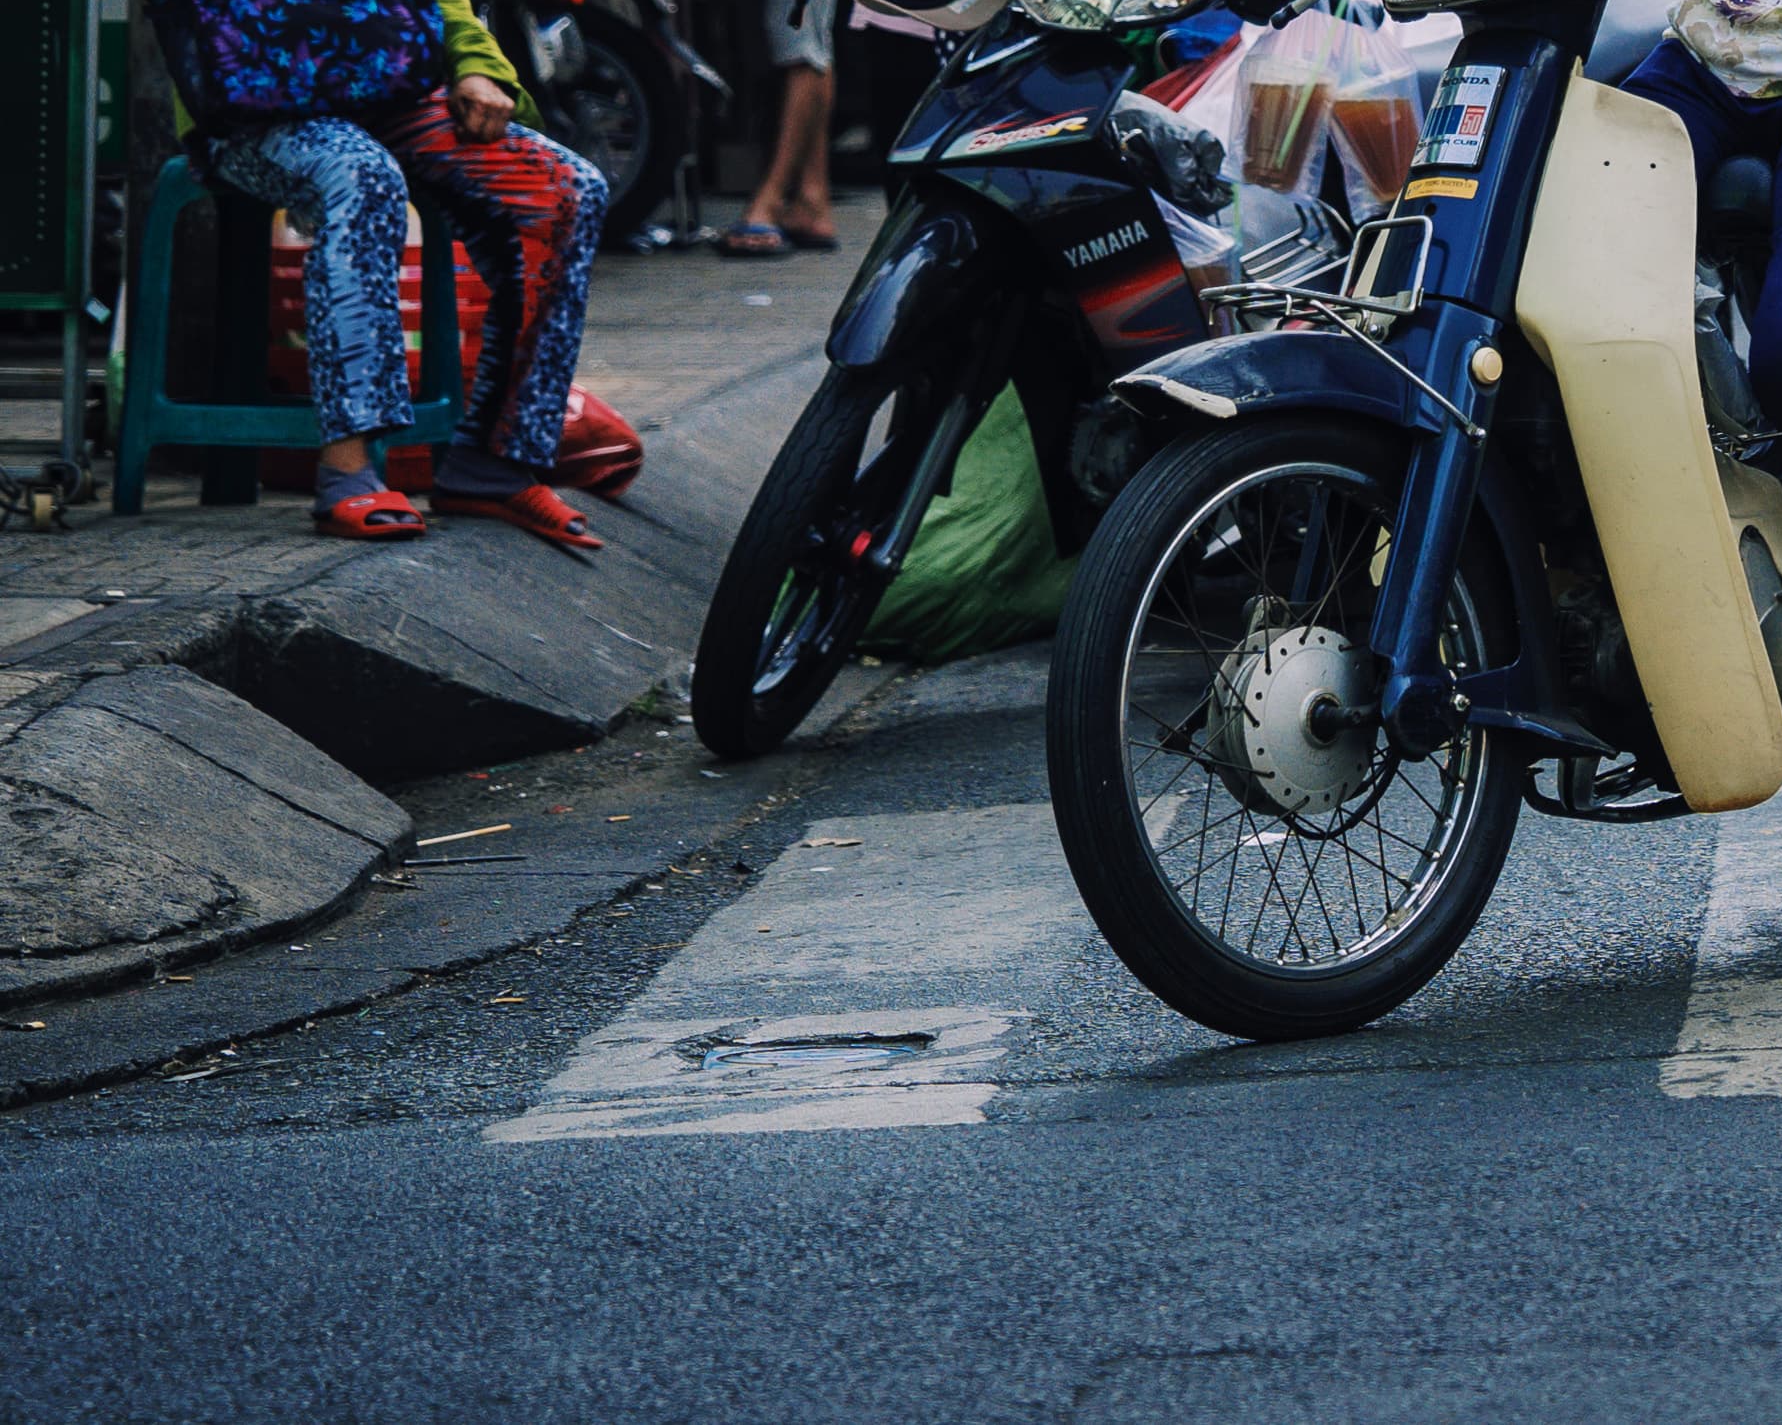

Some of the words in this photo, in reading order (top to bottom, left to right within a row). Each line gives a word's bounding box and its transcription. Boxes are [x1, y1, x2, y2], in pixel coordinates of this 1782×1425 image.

[1441, 75, 1490, 87] HONDA
[1460, 113, 1483, 134] 50
[1453, 138, 1478, 146] CUB
[1063, 219, 1150, 269] YAMAHA
